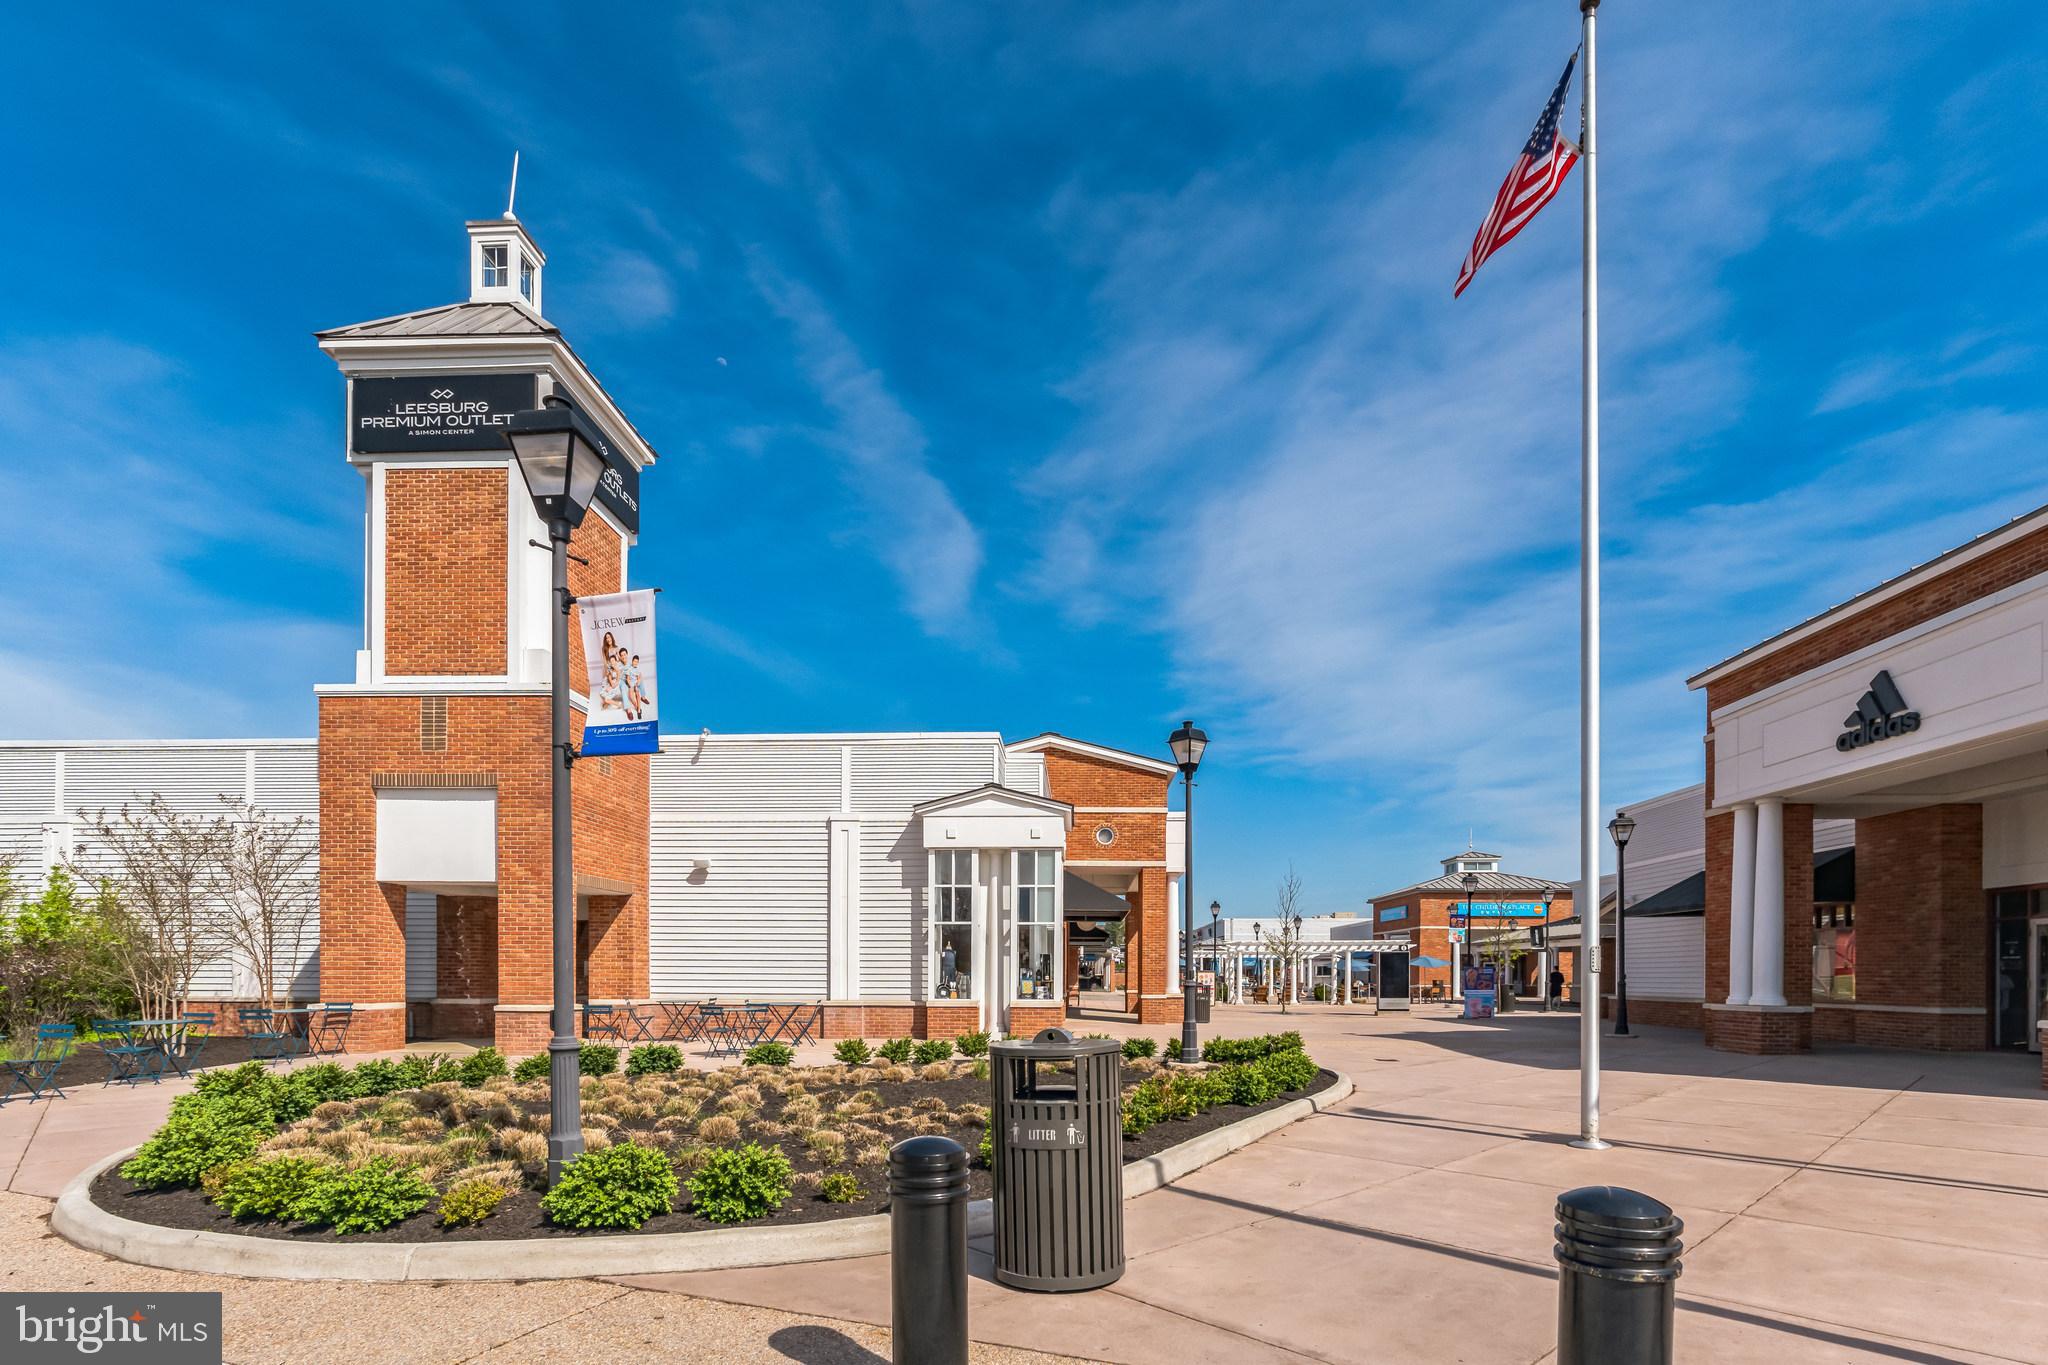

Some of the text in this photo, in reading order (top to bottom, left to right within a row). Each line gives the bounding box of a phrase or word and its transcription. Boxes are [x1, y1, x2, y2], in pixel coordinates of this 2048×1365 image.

[395, 401, 489, 415] LEESBURG
[361, 413, 515, 429] PREMIUM OUTLET
[603, 470, 638, 512] OUTLETS
[1835, 711, 1922, 752] adidas
[1028, 1129, 1056, 1141] LITTER
